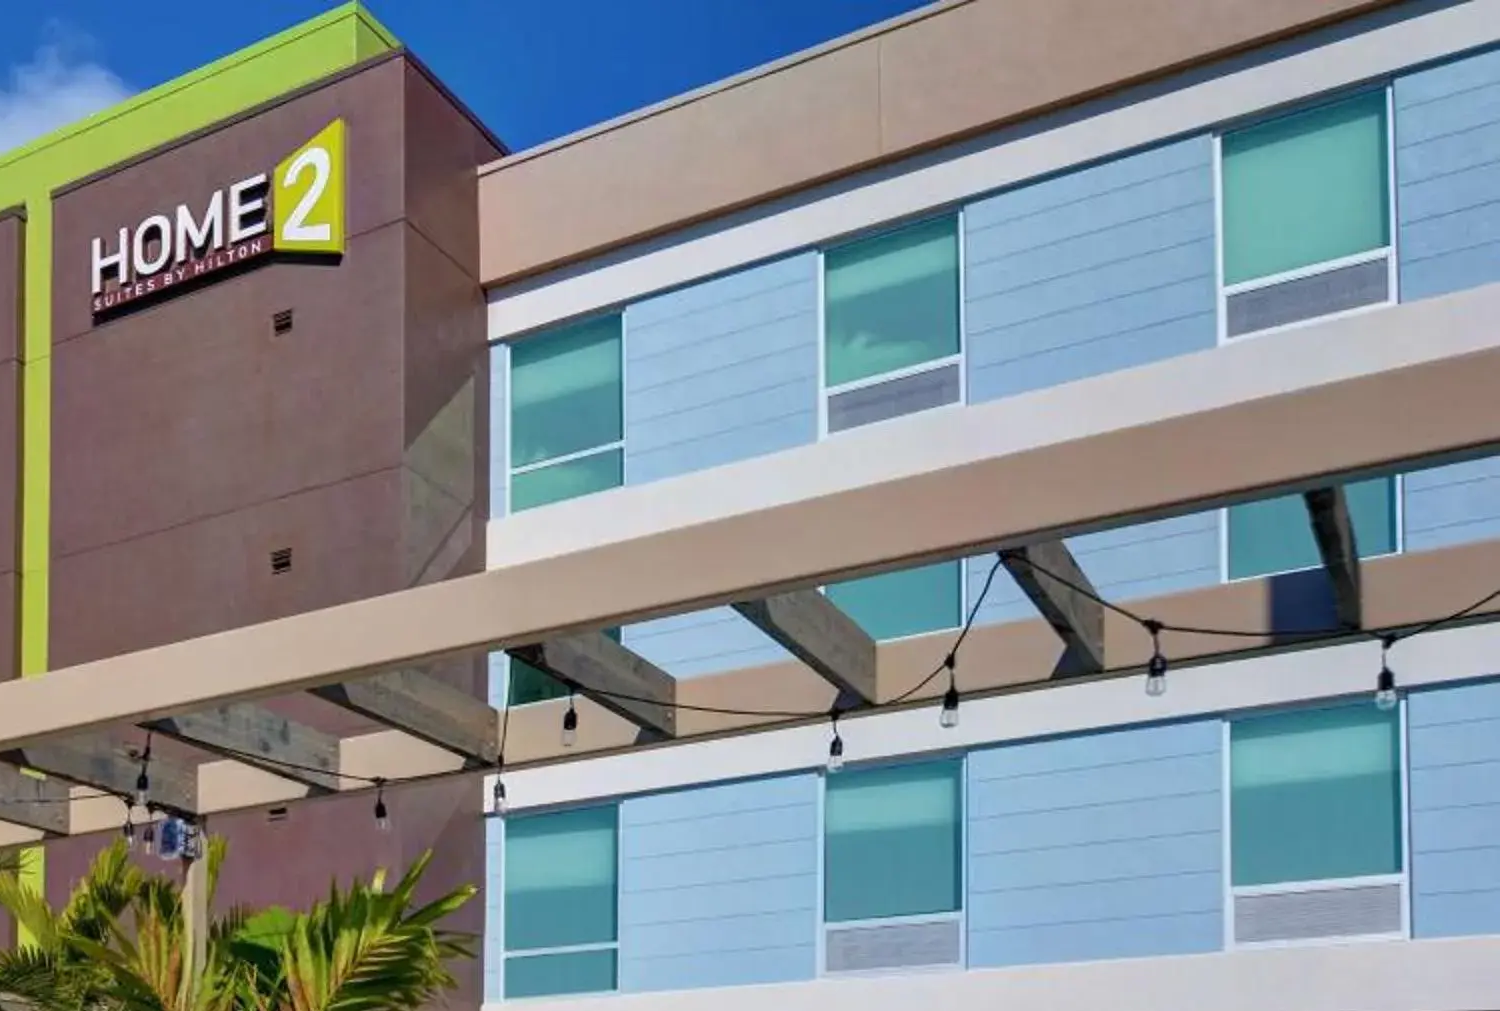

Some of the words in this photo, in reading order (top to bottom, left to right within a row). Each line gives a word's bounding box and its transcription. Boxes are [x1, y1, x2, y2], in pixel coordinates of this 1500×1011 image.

[91, 173, 268, 294] HOME
[281, 147, 331, 241] 2
[93, 279, 156, 311] SUITES
[164, 269, 187, 286] BY
[195, 240, 263, 274] HILTON
